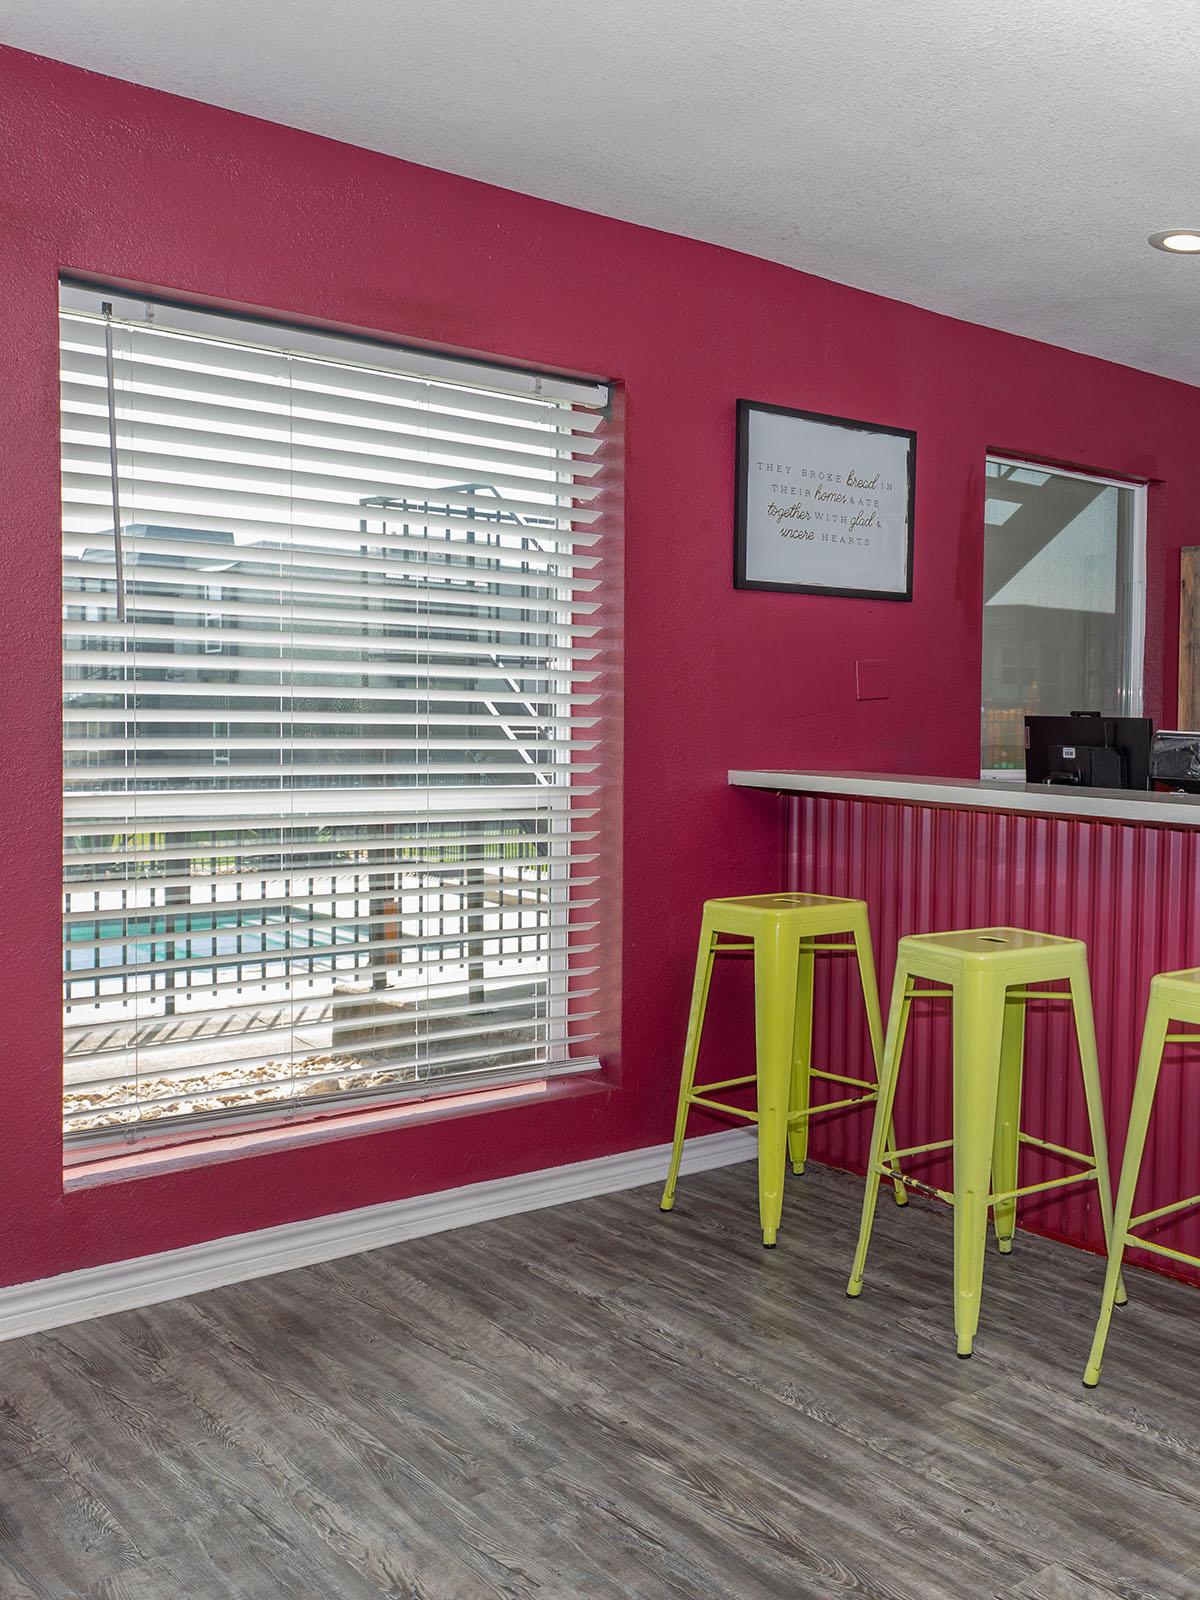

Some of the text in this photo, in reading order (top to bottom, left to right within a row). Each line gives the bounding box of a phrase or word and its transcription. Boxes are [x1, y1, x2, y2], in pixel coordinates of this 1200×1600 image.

[757, 462, 893, 491] THEY BROKE bread IN
[771, 484, 811, 497] THEIR
[814, 483, 848, 504] homes
[858, 498, 880, 508] ATE
[768, 502, 812, 524] together
[814, 512, 847, 524] WITH
[849, 510, 876, 532] glad
[821, 533, 870, 546] HEARTS
